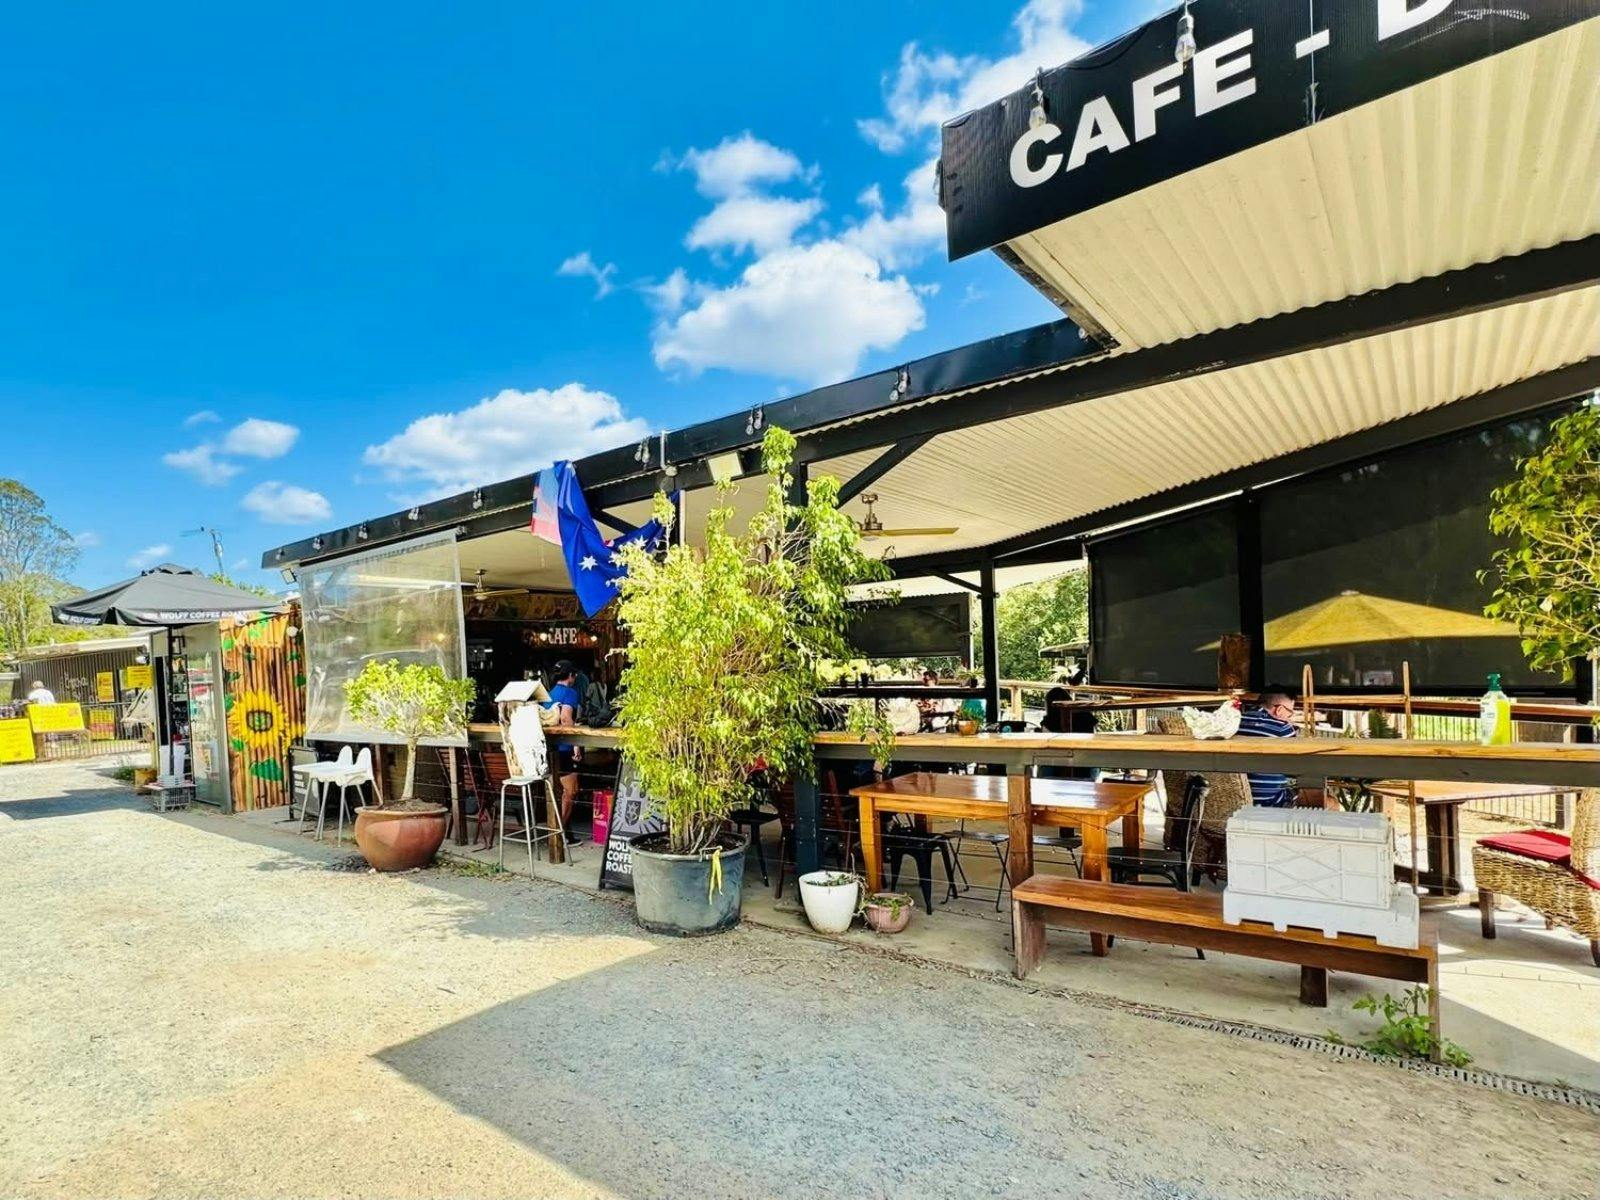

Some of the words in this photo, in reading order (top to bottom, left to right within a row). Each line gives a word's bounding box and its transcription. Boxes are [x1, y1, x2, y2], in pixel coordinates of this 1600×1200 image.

[1009, 28, 1257, 188] CAFE
[547, 627, 578, 645] CAFE
[609, 840, 629, 852] WOL
[607, 850, 632, 864] COFFE
[606, 861, 632, 874] ROAST
